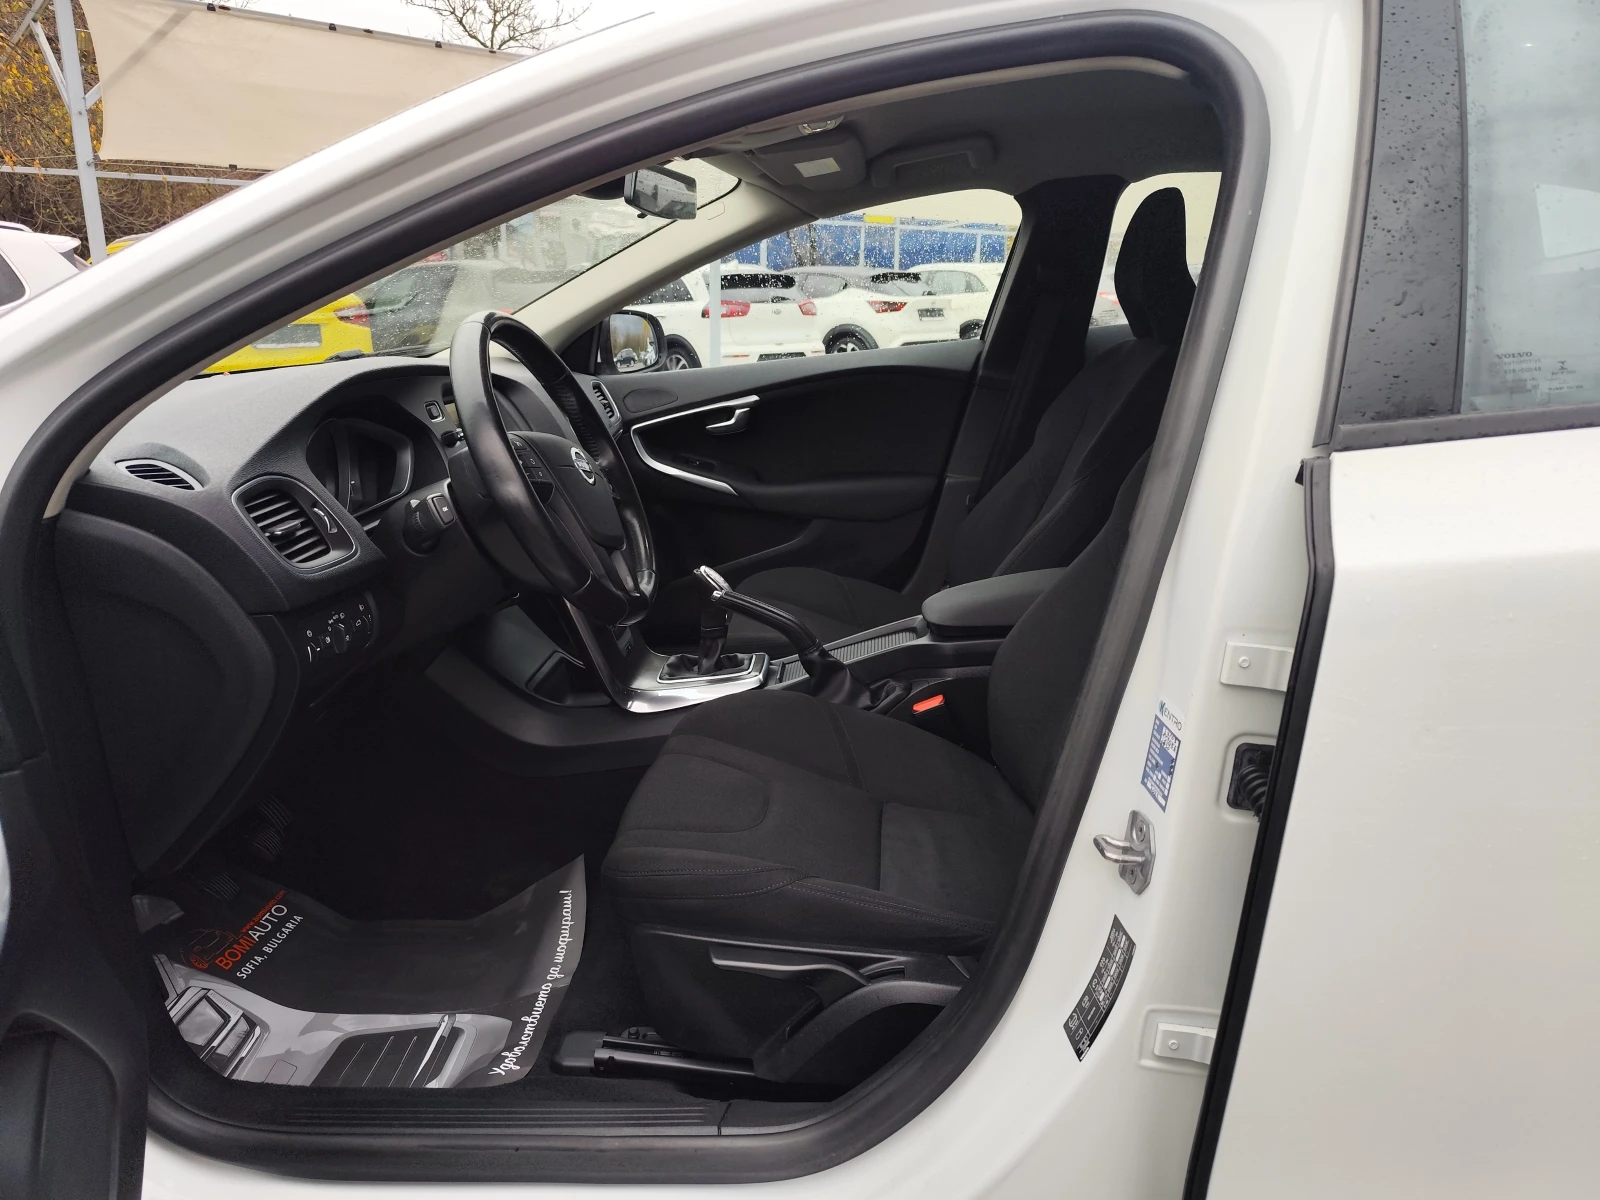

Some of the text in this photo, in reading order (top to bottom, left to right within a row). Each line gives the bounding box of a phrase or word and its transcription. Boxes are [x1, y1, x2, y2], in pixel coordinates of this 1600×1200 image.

[1496, 351, 1533, 360] VOLVO
[215, 904, 288, 970] BOMIAUTO
[236, 915, 304, 980] SOFIA, BULGARIA
[488, 889, 575, 1076] Удоволствието да шофираш!
